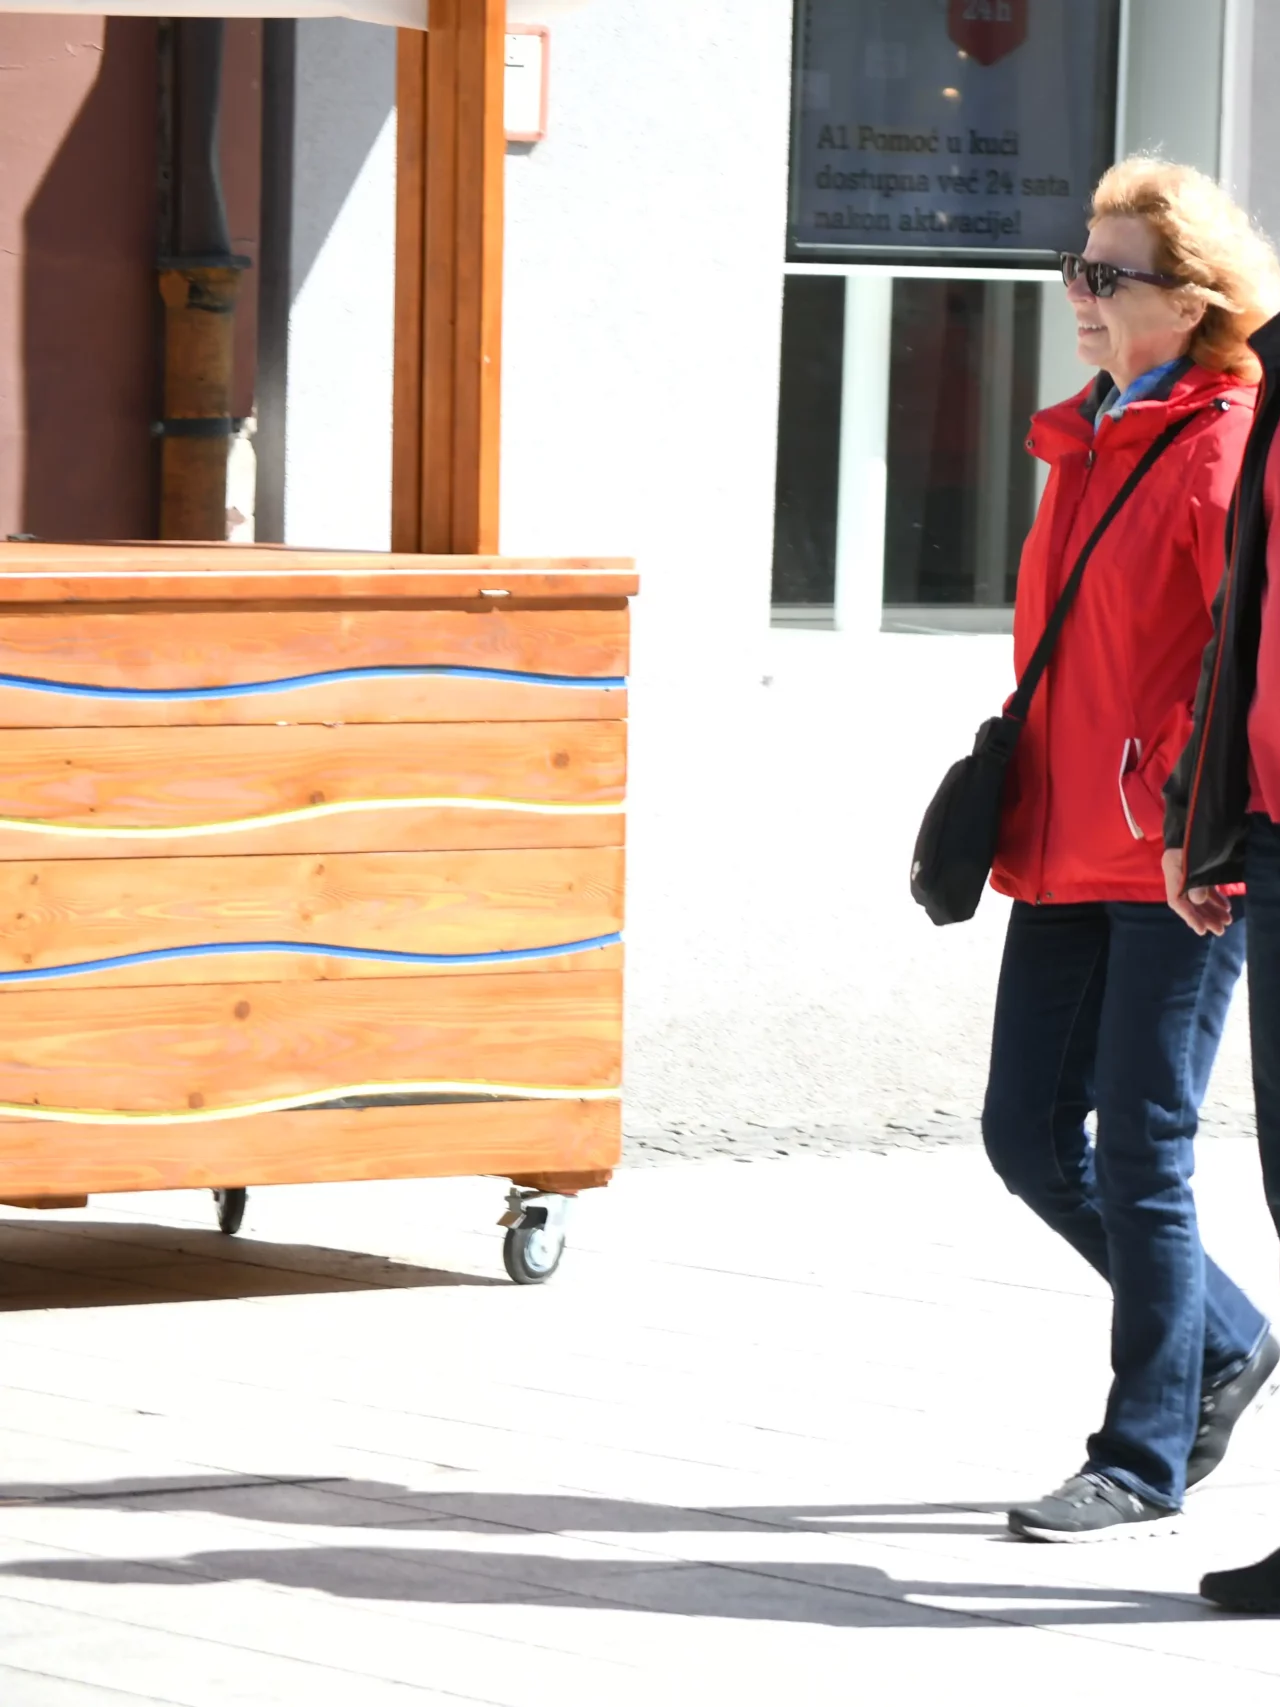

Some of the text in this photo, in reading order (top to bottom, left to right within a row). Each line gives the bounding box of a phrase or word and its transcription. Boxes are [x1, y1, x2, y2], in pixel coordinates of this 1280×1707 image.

[817, 124, 849, 150] A1
[858, 126, 939, 153] Pomoć
[946, 136, 962, 154] u
[815, 164, 929, 197] dostupna
[985, 170, 1014, 195] 24
[1020, 174, 1070, 197] sata
[814, 205, 891, 231] nakon
